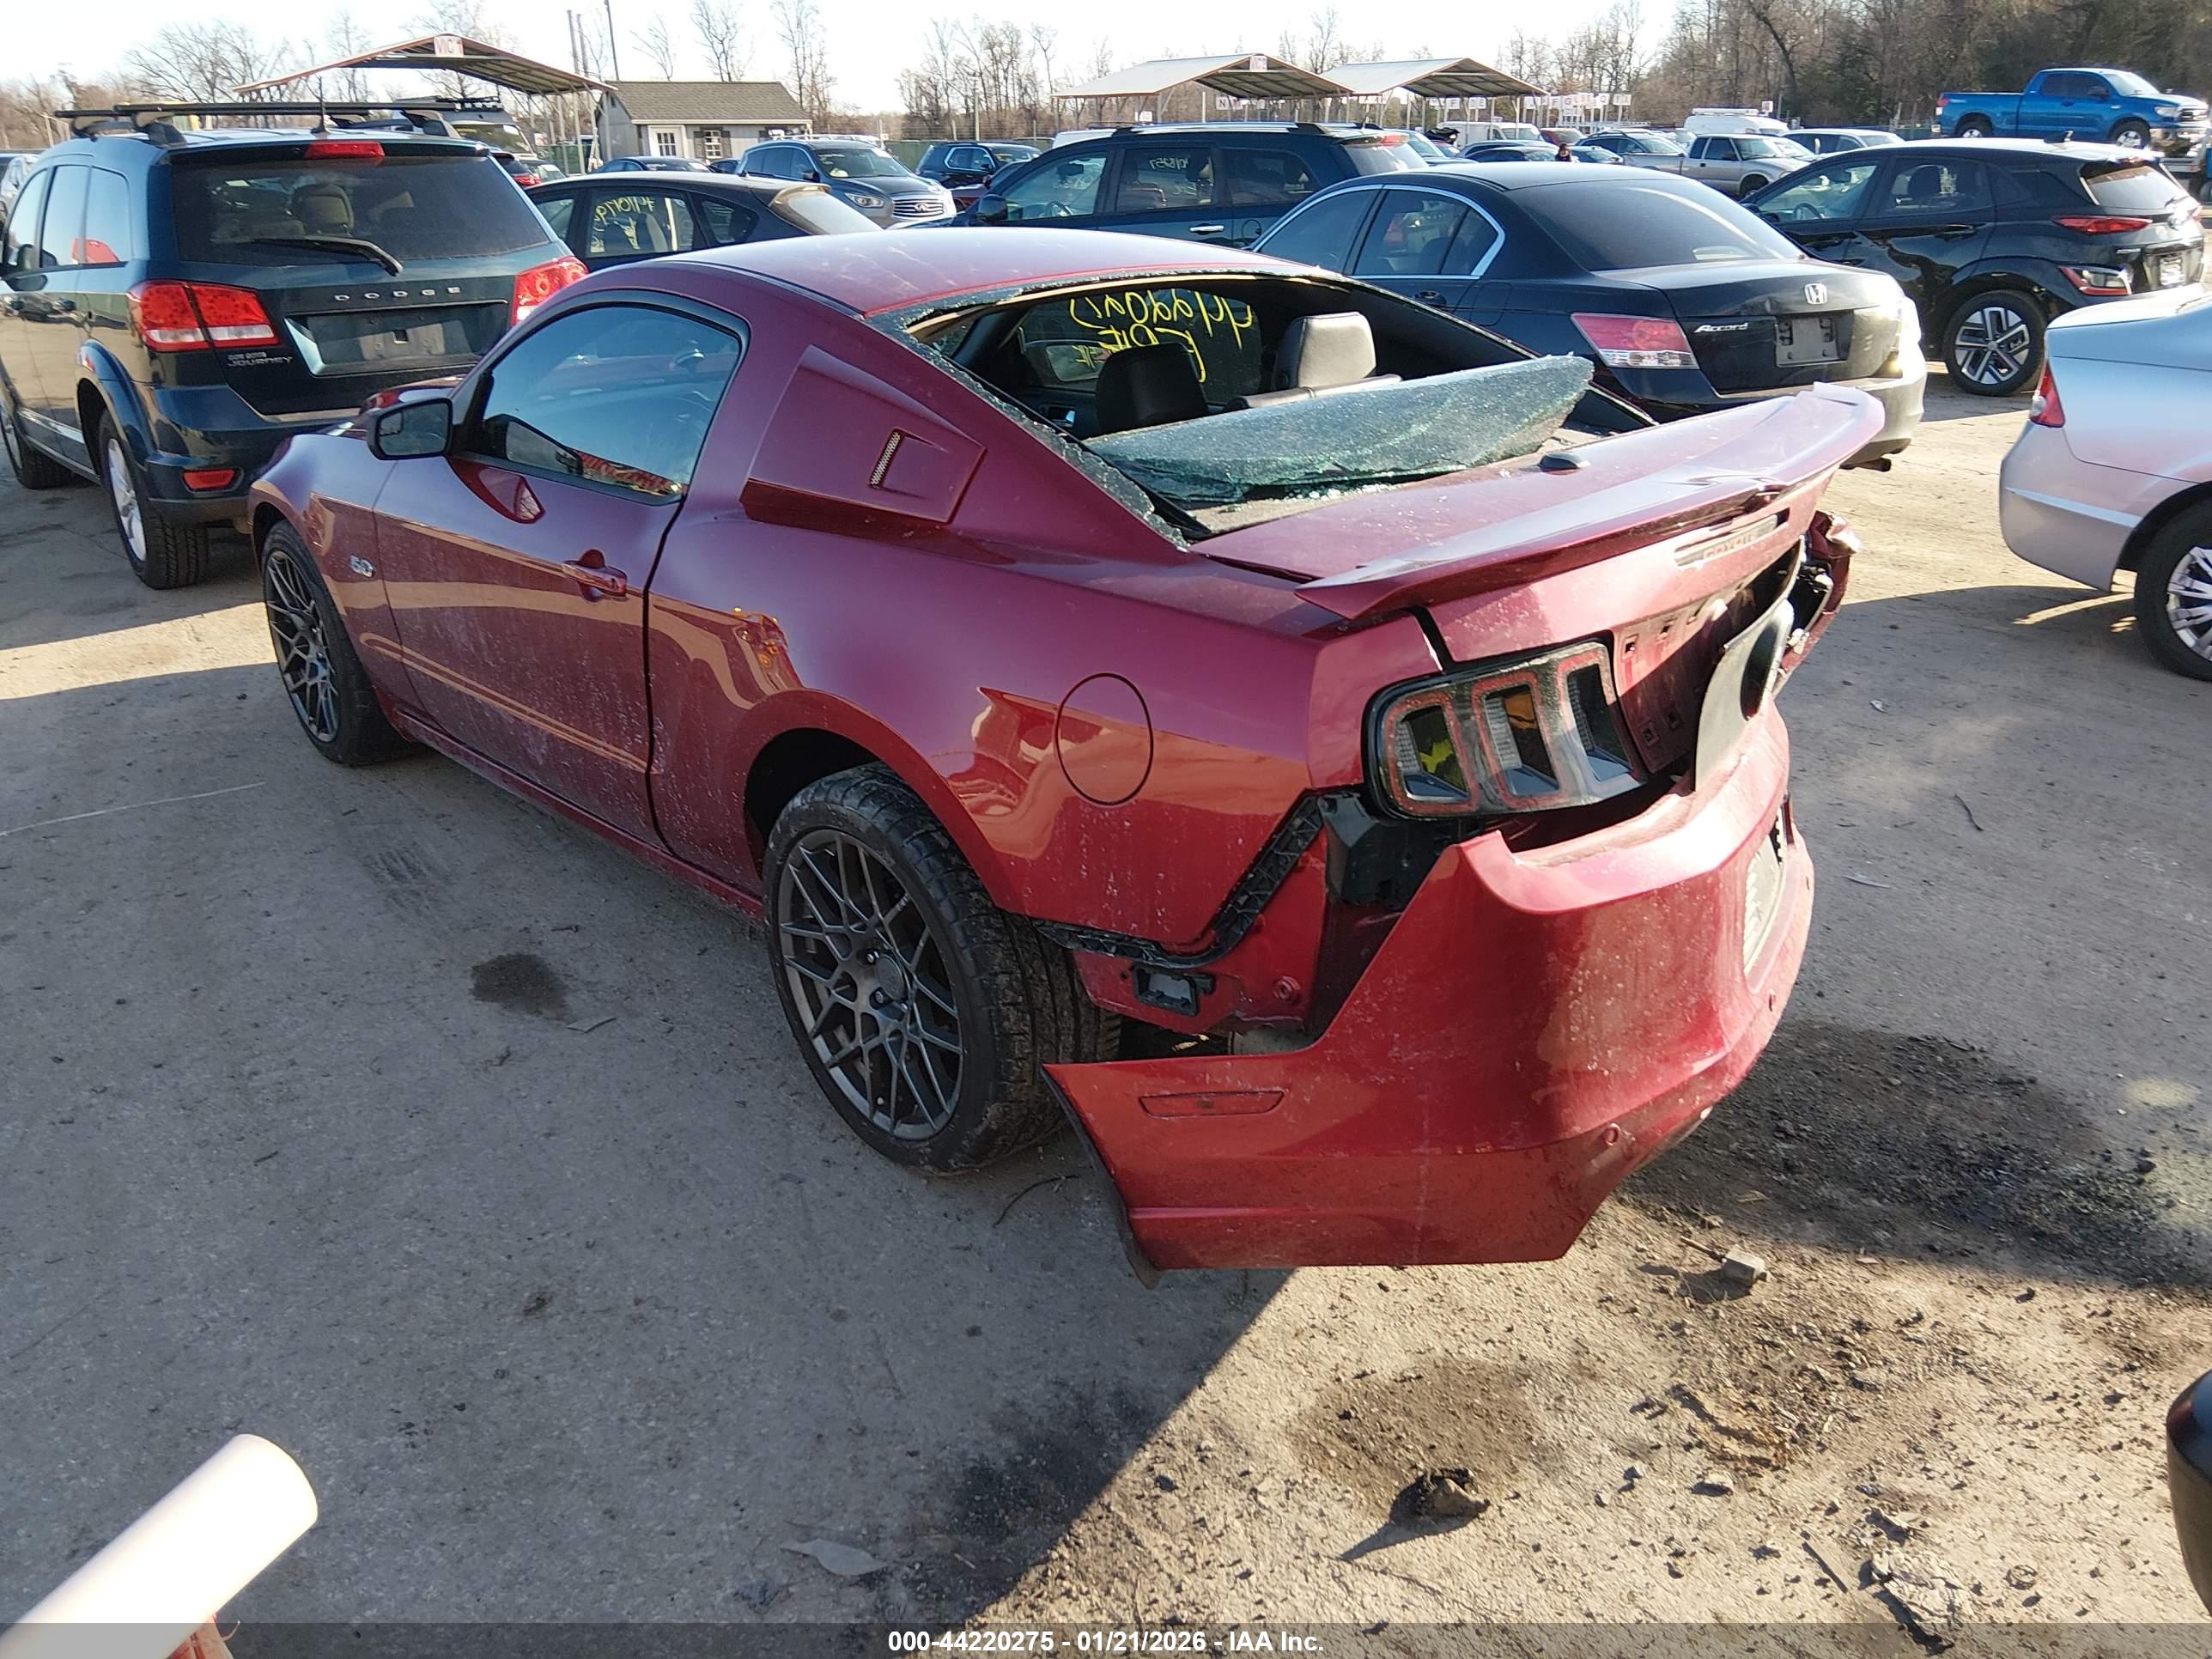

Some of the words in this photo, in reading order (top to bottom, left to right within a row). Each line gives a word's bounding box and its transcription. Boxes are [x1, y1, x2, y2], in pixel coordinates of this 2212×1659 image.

[334, 286, 461, 302] DODGE
[1693, 322, 1749, 334] Accord
[227, 356, 295, 368] JOURNEY
